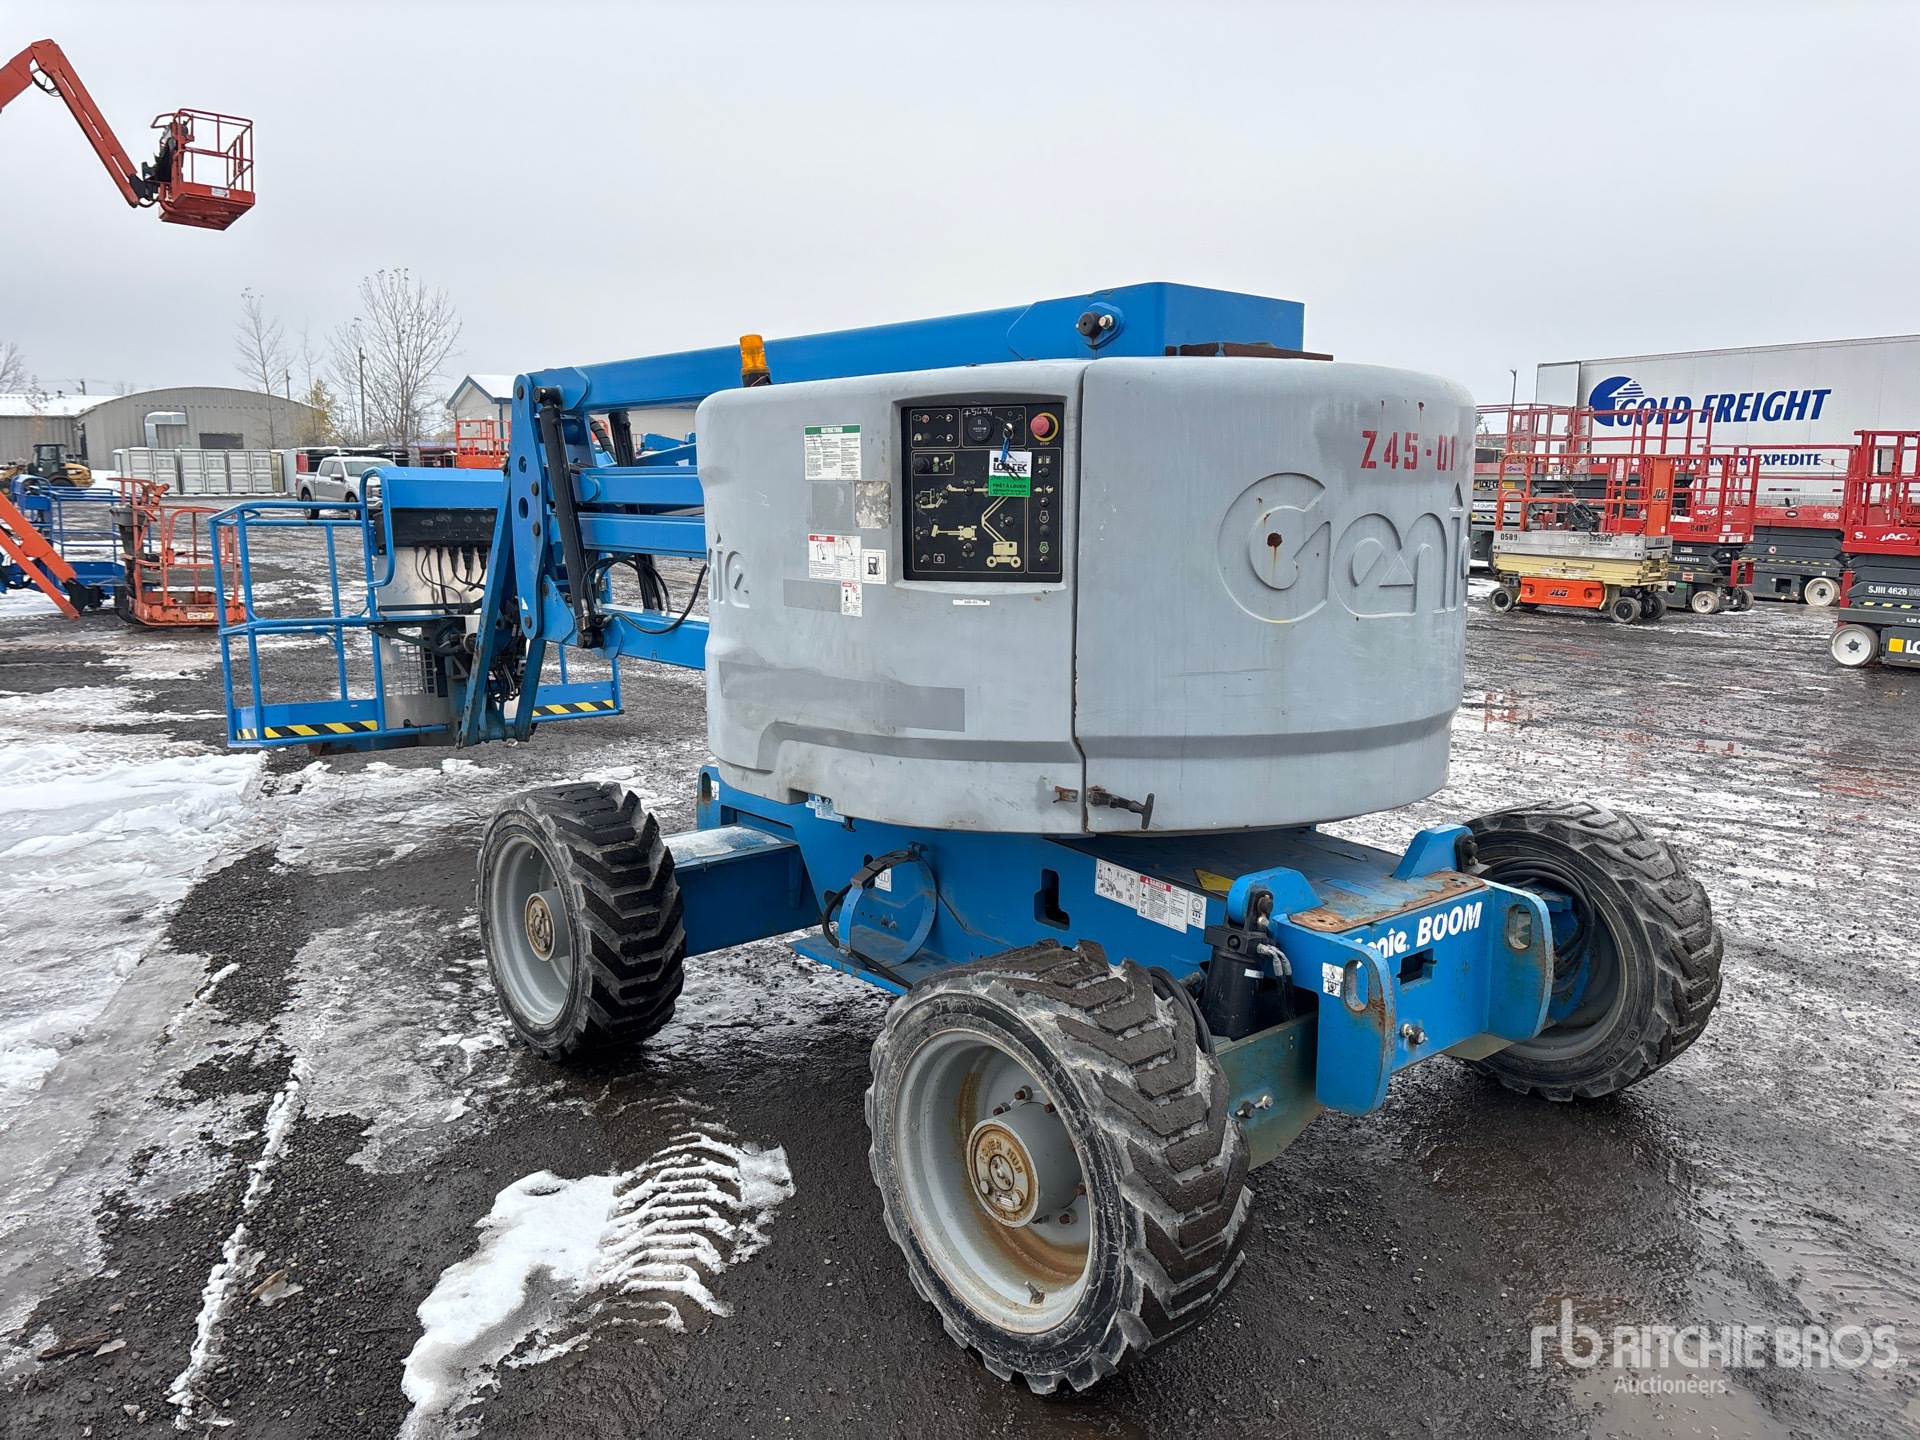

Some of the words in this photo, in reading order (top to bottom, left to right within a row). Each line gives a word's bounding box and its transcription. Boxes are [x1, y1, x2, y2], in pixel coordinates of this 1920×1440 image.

[1616, 396, 1692, 427] GOLD
[1698, 389, 1832, 424] FREIGHT
[1758, 453, 1822, 467] EXPEDITE
[1653, 488, 1667, 499] JLG
[1822, 511, 1839, 520] 4626
[1217, 471, 1471, 624] Geni
[1548, 588, 1568, 597] JLG
[1887, 586, 1908, 596] 4626
[1149, 876, 1167, 890] DANGER
[1416, 901, 1483, 948] BOOM
